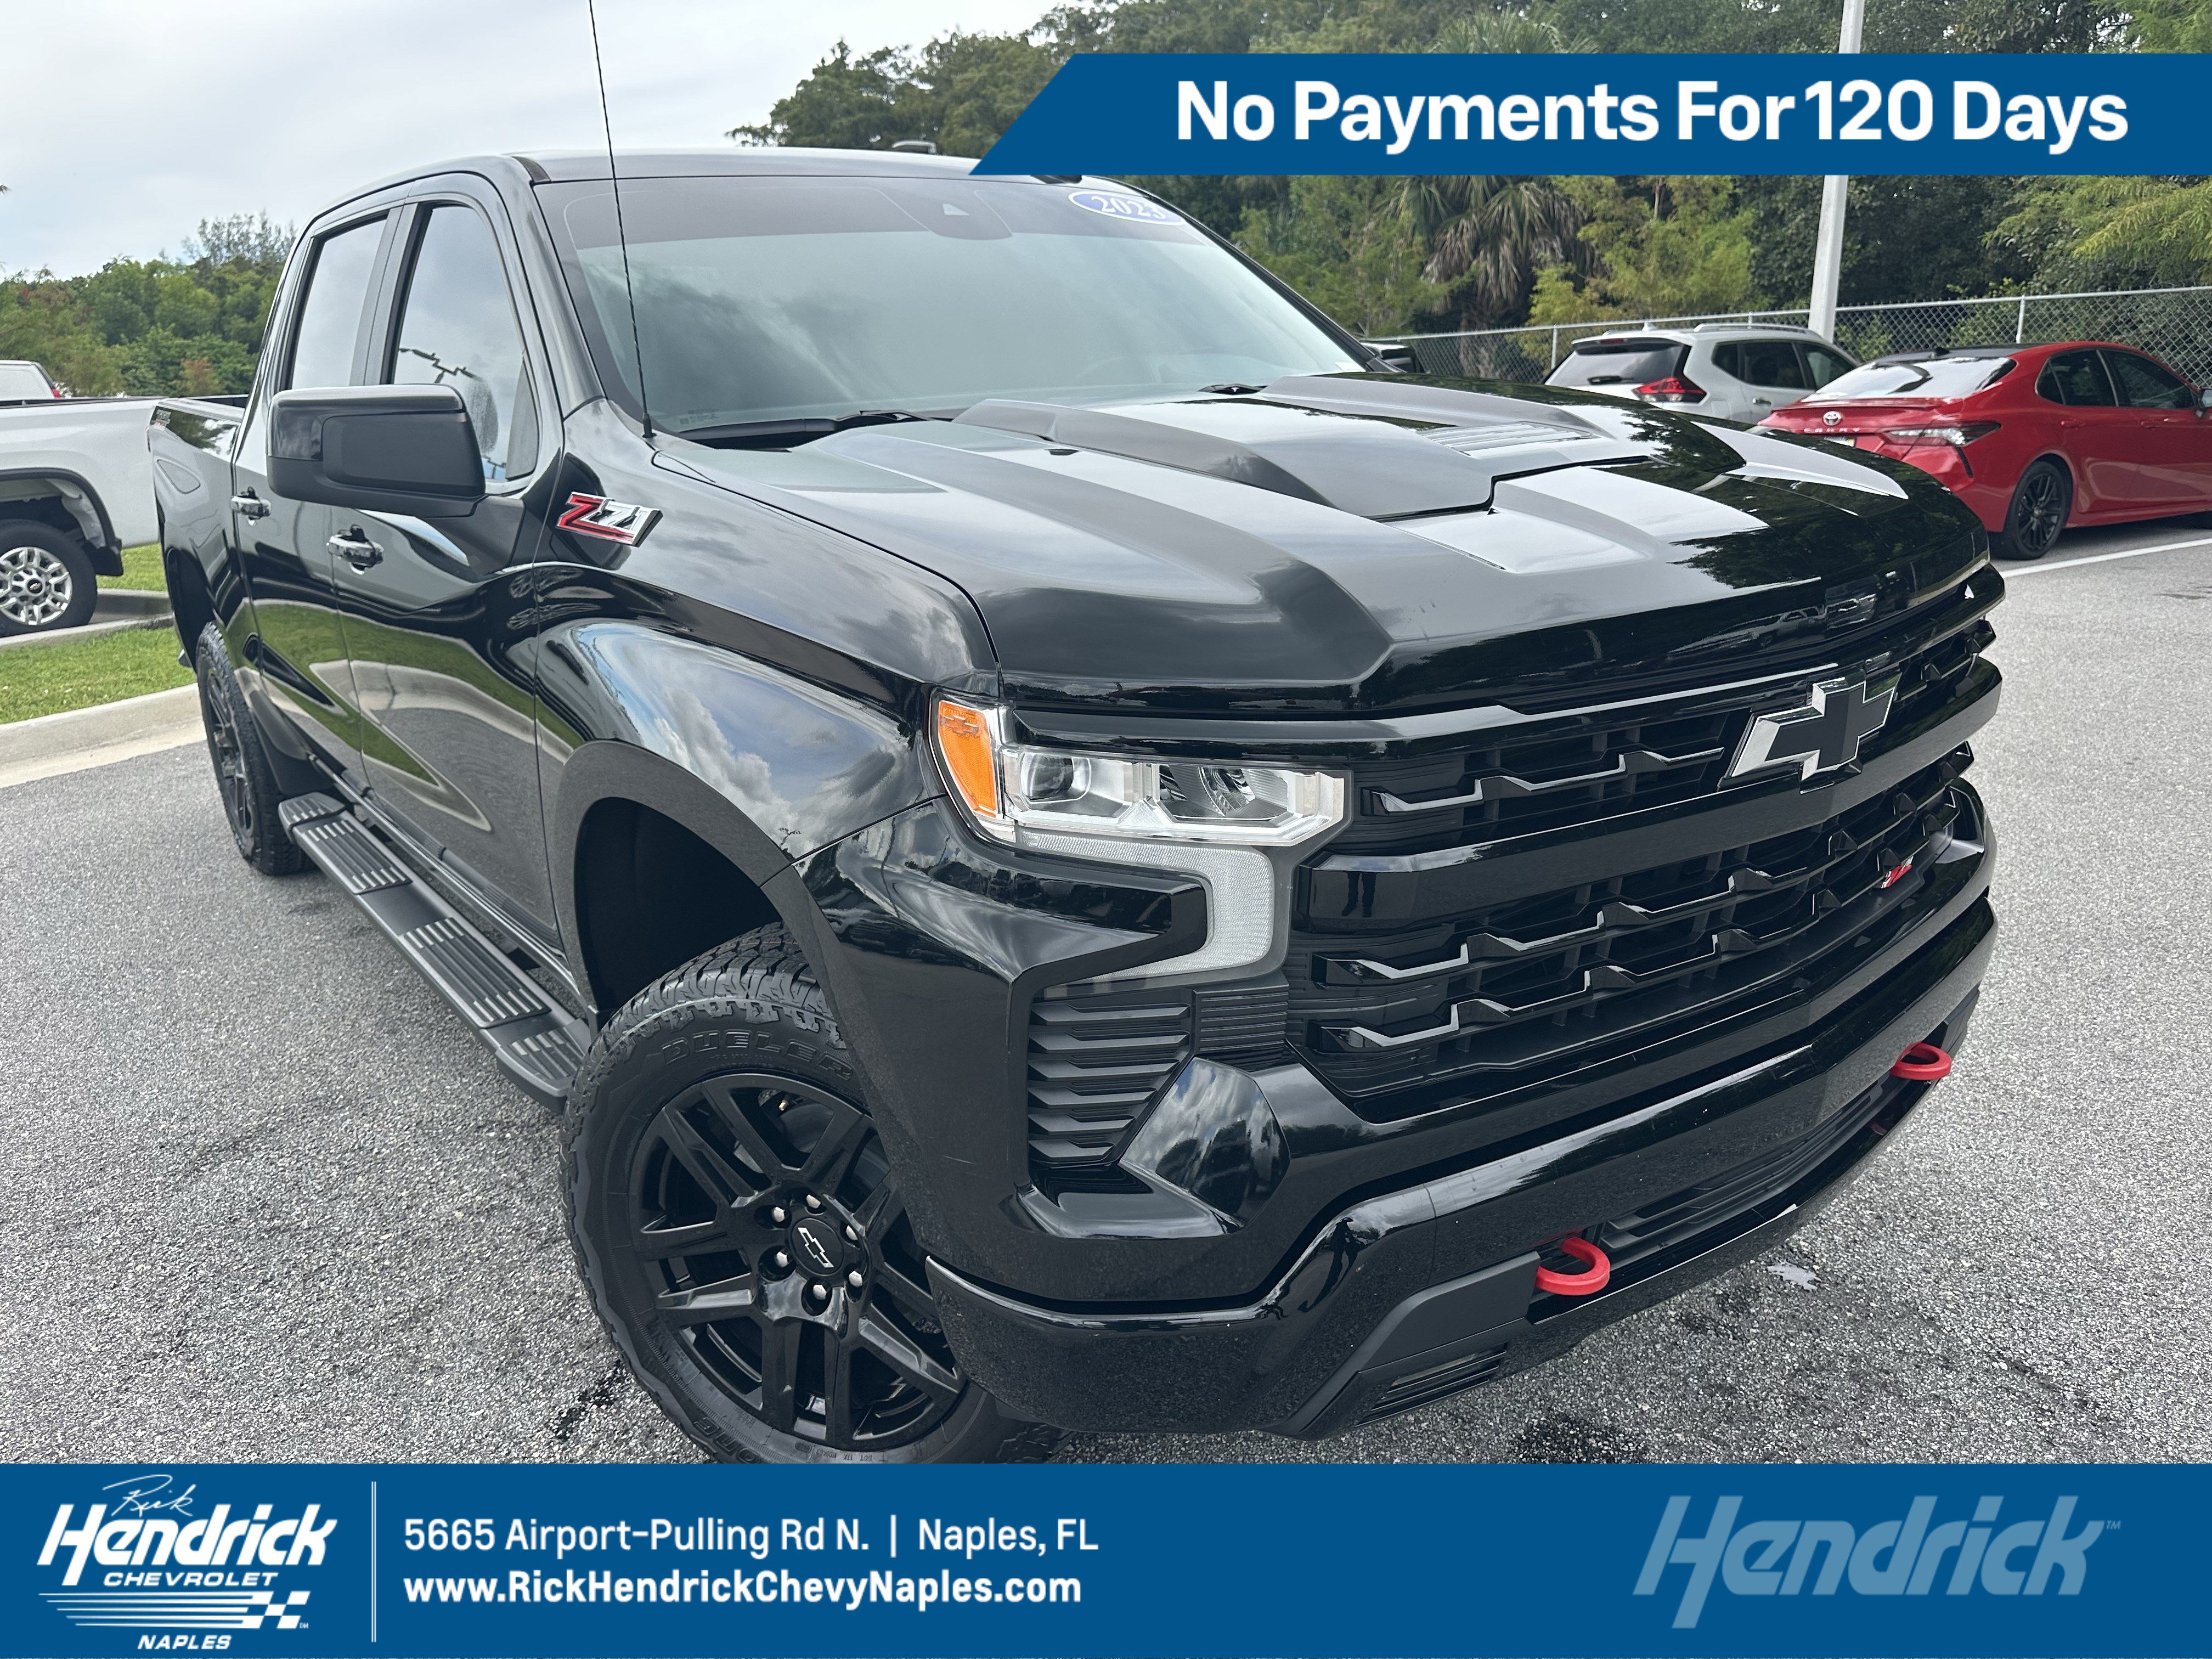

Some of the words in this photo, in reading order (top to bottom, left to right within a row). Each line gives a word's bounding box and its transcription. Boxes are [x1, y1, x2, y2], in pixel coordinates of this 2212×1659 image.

[1091, 195, 1166, 219] 2023
[556, 491, 663, 548] Z71
[661, 1029, 854, 1081] DUELER
